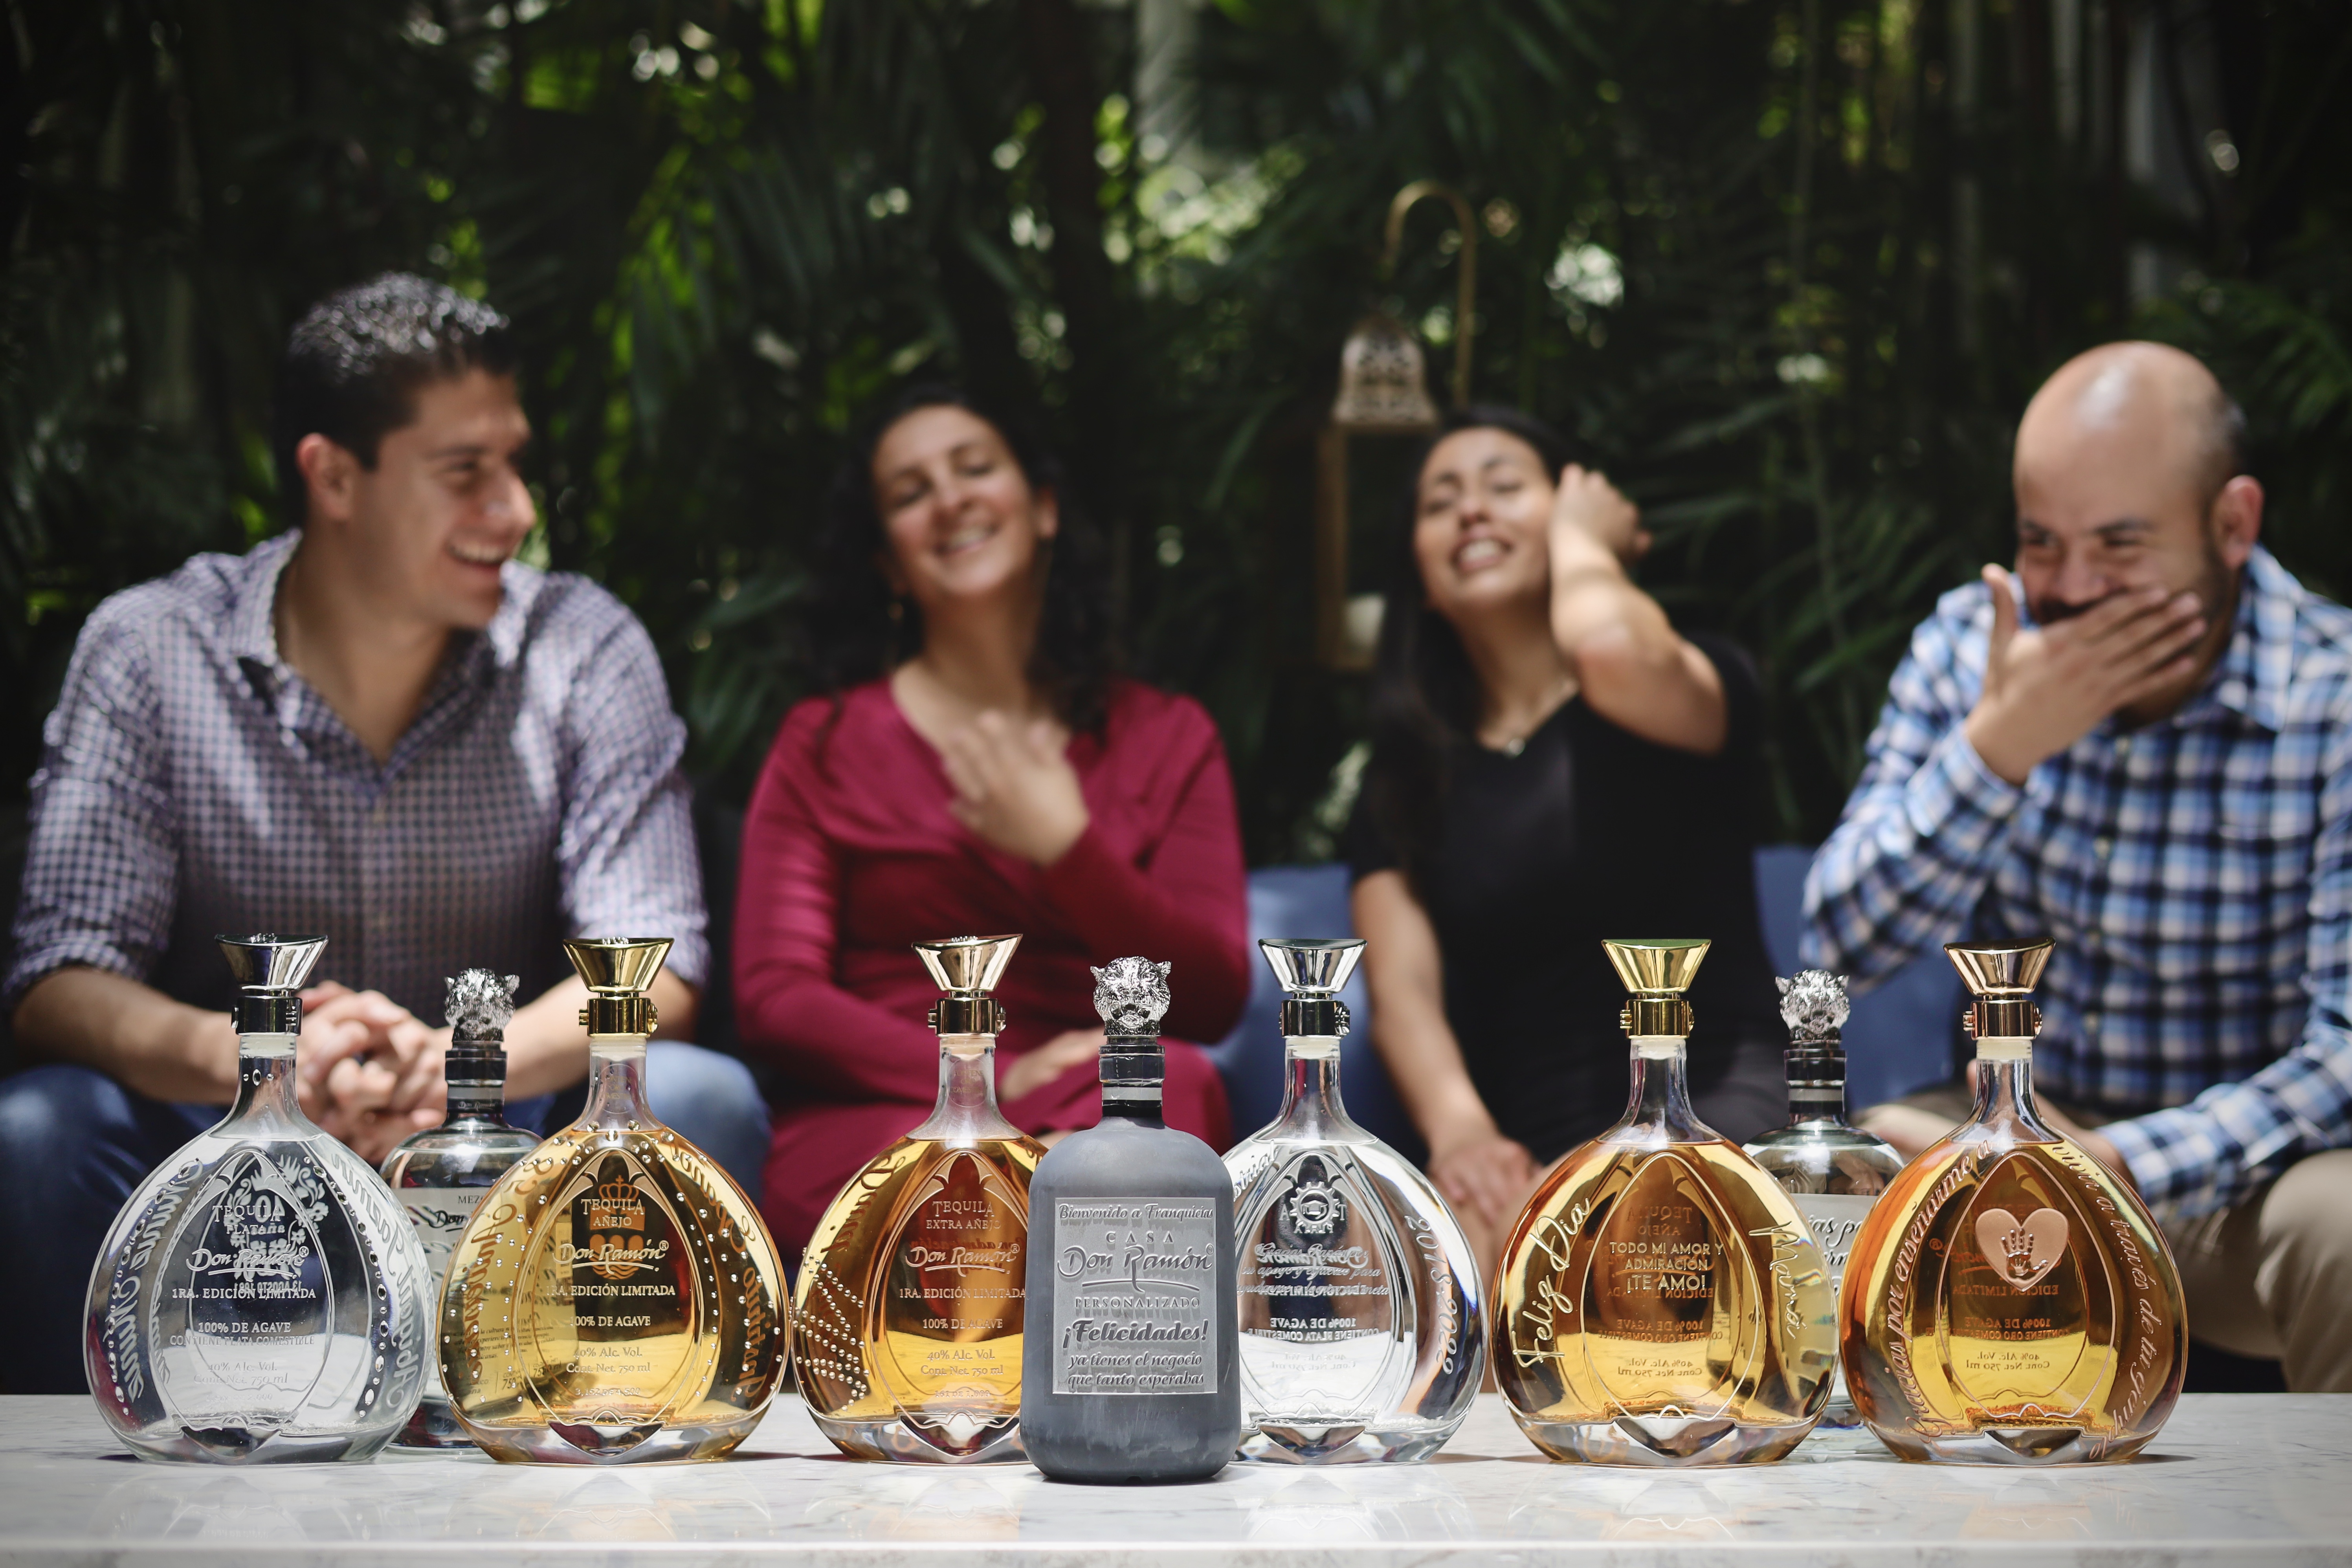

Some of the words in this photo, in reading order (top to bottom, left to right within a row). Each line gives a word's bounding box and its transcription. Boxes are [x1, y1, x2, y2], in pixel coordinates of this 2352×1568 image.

[1975, 1139, 1993, 1160] a
[2052, 1146, 2101, 1191] vivir
[581, 1199, 645, 1215] TEQUILA
[932, 1201, 995, 1217] TEQUILA
[2096, 1197, 2115, 1211] a
[212, 1205, 281, 1222] TEQUILA
[427, 1210, 468, 1228] Don
[1059, 1203, 1128, 1219] Bienvenido
[1131, 1208, 1143, 1218] a
[1145, 1203, 1214, 1223] Franquicias
[593, 1216, 632, 1228] AÑEJO
[926, 1220, 963, 1229] EXTRA
[965, 1218, 1001, 1231] AÑEJO
[226, 1225, 266, 1234] PLATA
[1106, 1231, 1174, 1243] CASA
[552, 1243, 594, 1264] Don
[1609, 1242, 1648, 1254] TODO
[1651, 1242, 1666, 1254] MI
[1670, 1243, 1711, 1255] AMOR
[1714, 1243, 1724, 1255] Y
[2110, 1218, 2157, 1290] través
[185, 1248, 233, 1271] Don
[905, 1246, 947, 1267] Don
[1057, 1245, 1113, 1277] Don
[1624, 1257, 1708, 1271] ADMIRACIÓN
[1258, 1267, 1293, 1278] apoyo
[1349, 1268, 1382, 1280] para
[546, 1285, 568, 1296] 1RA.
[571, 1283, 619, 1296] EDICIÓN
[621, 1285, 676, 1296] LIMITADA
[1627, 1274, 1653, 1294] ¡TE
[1657, 1275, 1706, 1291] AMO!
[172, 1289, 199, 1298] 1RA.
[259, 1288, 316, 1299] LIMITADA
[899, 1288, 921, 1298] 1RA.
[923, 1286, 971, 1298] EDICIÓN
[973, 1288, 1026, 1298] LIMITADA
[1075, 1297, 1200, 1308] PERSONALIZADO
[1887, 1284, 1912, 1343] por
[2139, 1297, 2163, 1335] de
[198, 1322, 229, 1333] 100%
[231, 1322, 249, 1333] DE
[251, 1322, 292, 1333] AGAVE
[570, 1316, 595, 1326] 100%
[598, 1316, 613, 1326] DE
[615, 1316, 651, 1326] AGAVE
[923, 1319, 949, 1329] 100%
[951, 1319, 967, 1329] DE
[968, 1319, 1003, 1329] AGAVE
[1512, 1275, 1573, 1368] Feliz
[170, 1335, 222, 1346] CONTIENE
[224, 1335, 254, 1346] PLATA
[255, 1335, 315, 1346] COMESTIBLE
[1062, 1318, 1209, 1349] ¡Felicidades!
[573, 1347, 596, 1360] 40%
[599, 1346, 620, 1357] Alc.
[622, 1346, 643, 1357] Vol.
[927, 1350, 950, 1362] 40%
[952, 1349, 973, 1360] Alc.
[975, 1349, 995, 1359] Vol.
[2140, 1336, 2157, 1369] tu
[207, 1362, 230, 1372] 40%
[233, 1361, 254, 1372] Alc.
[258, 1361, 277, 1371] Vol.
[1067, 1355, 1088, 1369] ya
[1090, 1352, 1132, 1366] tienes
[1135, 1351, 1149, 1365] el
[1151, 1351, 1202, 1370] negocio
[566, 1363, 593, 1373] Cont.
[596, 1363, 616, 1373] Net.
[618, 1366, 635, 1374] 750
[637, 1362, 651, 1372] ml
[920, 1365, 947, 1375] Cont.
[949, 1366, 970, 1375] Net.
[972, 1368, 988, 1377] 750
[990, 1364, 1004, 1374] ml
[225, 1375, 247, 1384] Net.
[251, 1376, 270, 1385] 750
[272, 1373, 288, 1384] ml
[1068, 1374, 1092, 1389] que
[1095, 1373, 1135, 1385] tanto
[1139, 1370, 1204, 1389] esperabas
[1885, 1341, 1956, 1444] Gracias
